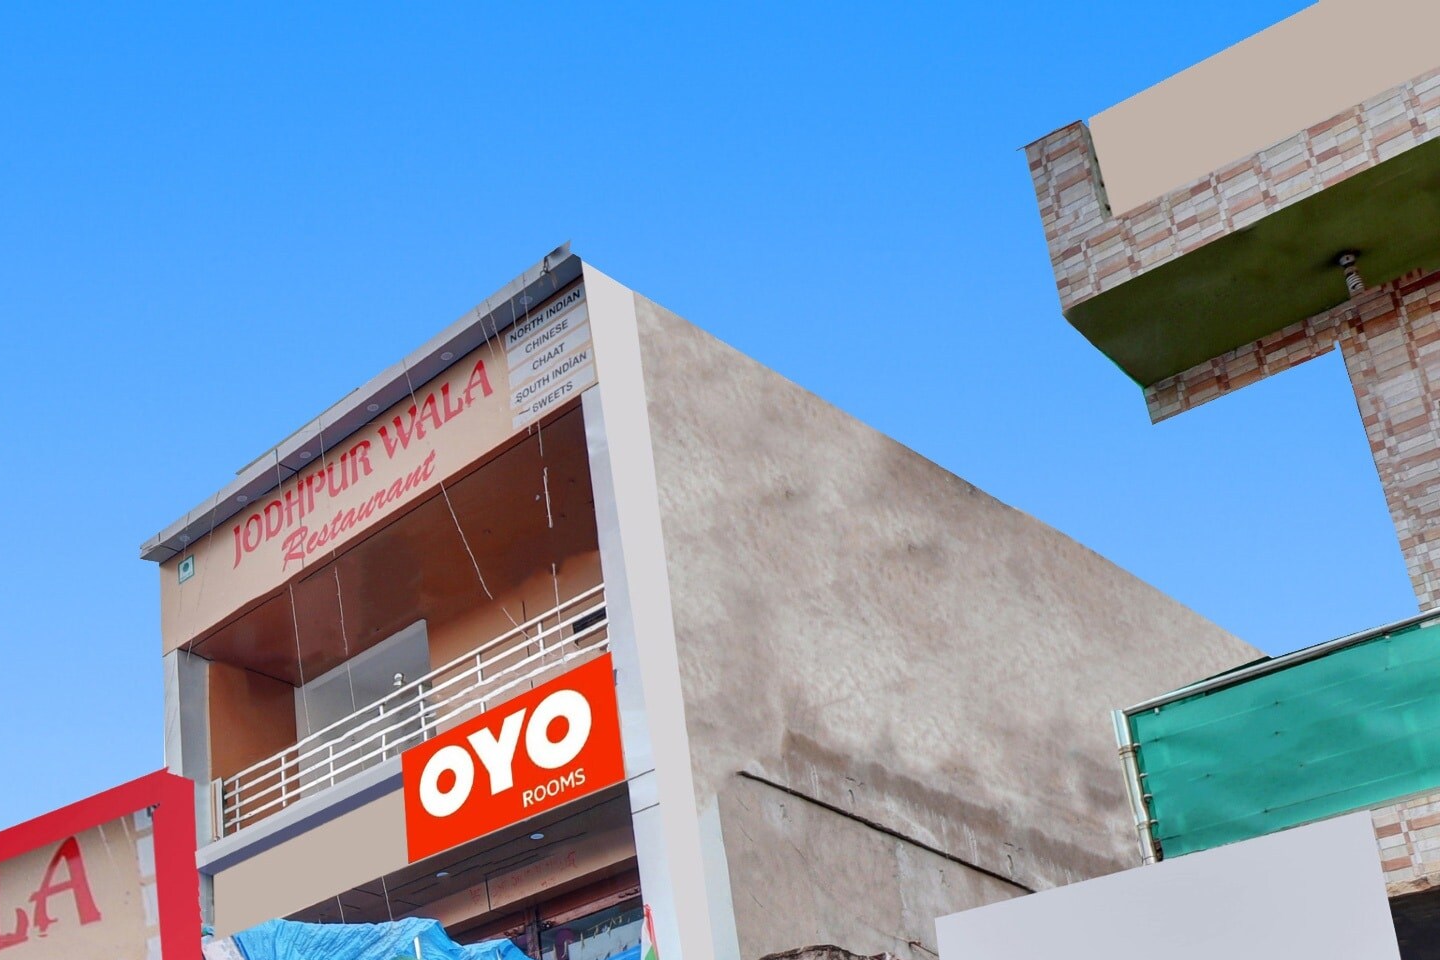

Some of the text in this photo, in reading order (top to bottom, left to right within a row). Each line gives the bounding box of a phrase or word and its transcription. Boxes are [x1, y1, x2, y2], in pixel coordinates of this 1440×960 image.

[510, 289, 581, 343] NORTH INDIAN
[525, 319, 568, 353] CHINESE
[532, 343, 565, 370] CHAAT
[516, 376, 550, 403] SOUTH
[532, 381, 573, 412] SWEETS
[233, 360, 493, 570] JODHPUR WALA
[282, 449, 436, 572] Restaurant
[419, 689, 592, 818] OYO
[522, 769, 585, 808] ROOMS
